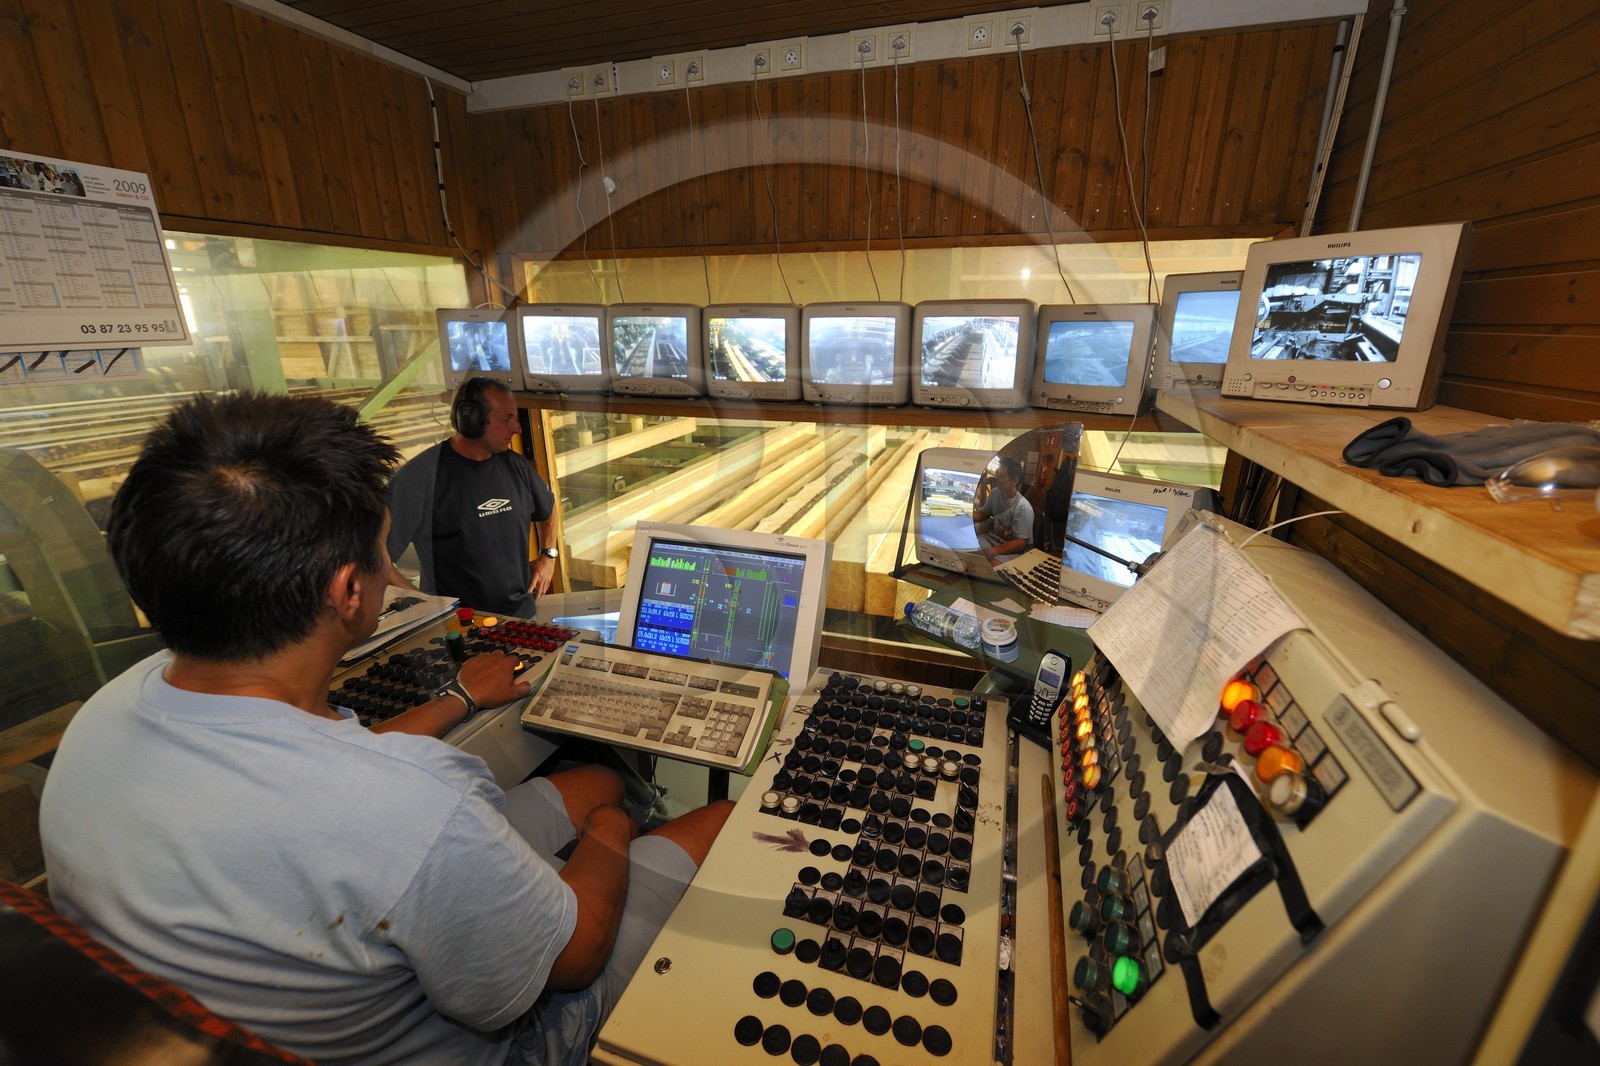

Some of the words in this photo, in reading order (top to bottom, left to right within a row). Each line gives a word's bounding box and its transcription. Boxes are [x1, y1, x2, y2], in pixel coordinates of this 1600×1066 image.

[113, 179, 147, 195] 2009
[1327, 241, 1351, 249] PHILIPS
[80, 324, 97, 334] 03
[100, 324, 113, 333] 87
[117, 324, 132, 333] 23
[135, 324, 149, 333] 95
[151, 323, 165, 333] 95
[1104, 486, 1121, 494] PHILIPS
[478, 506, 512, 518] UMBRO
